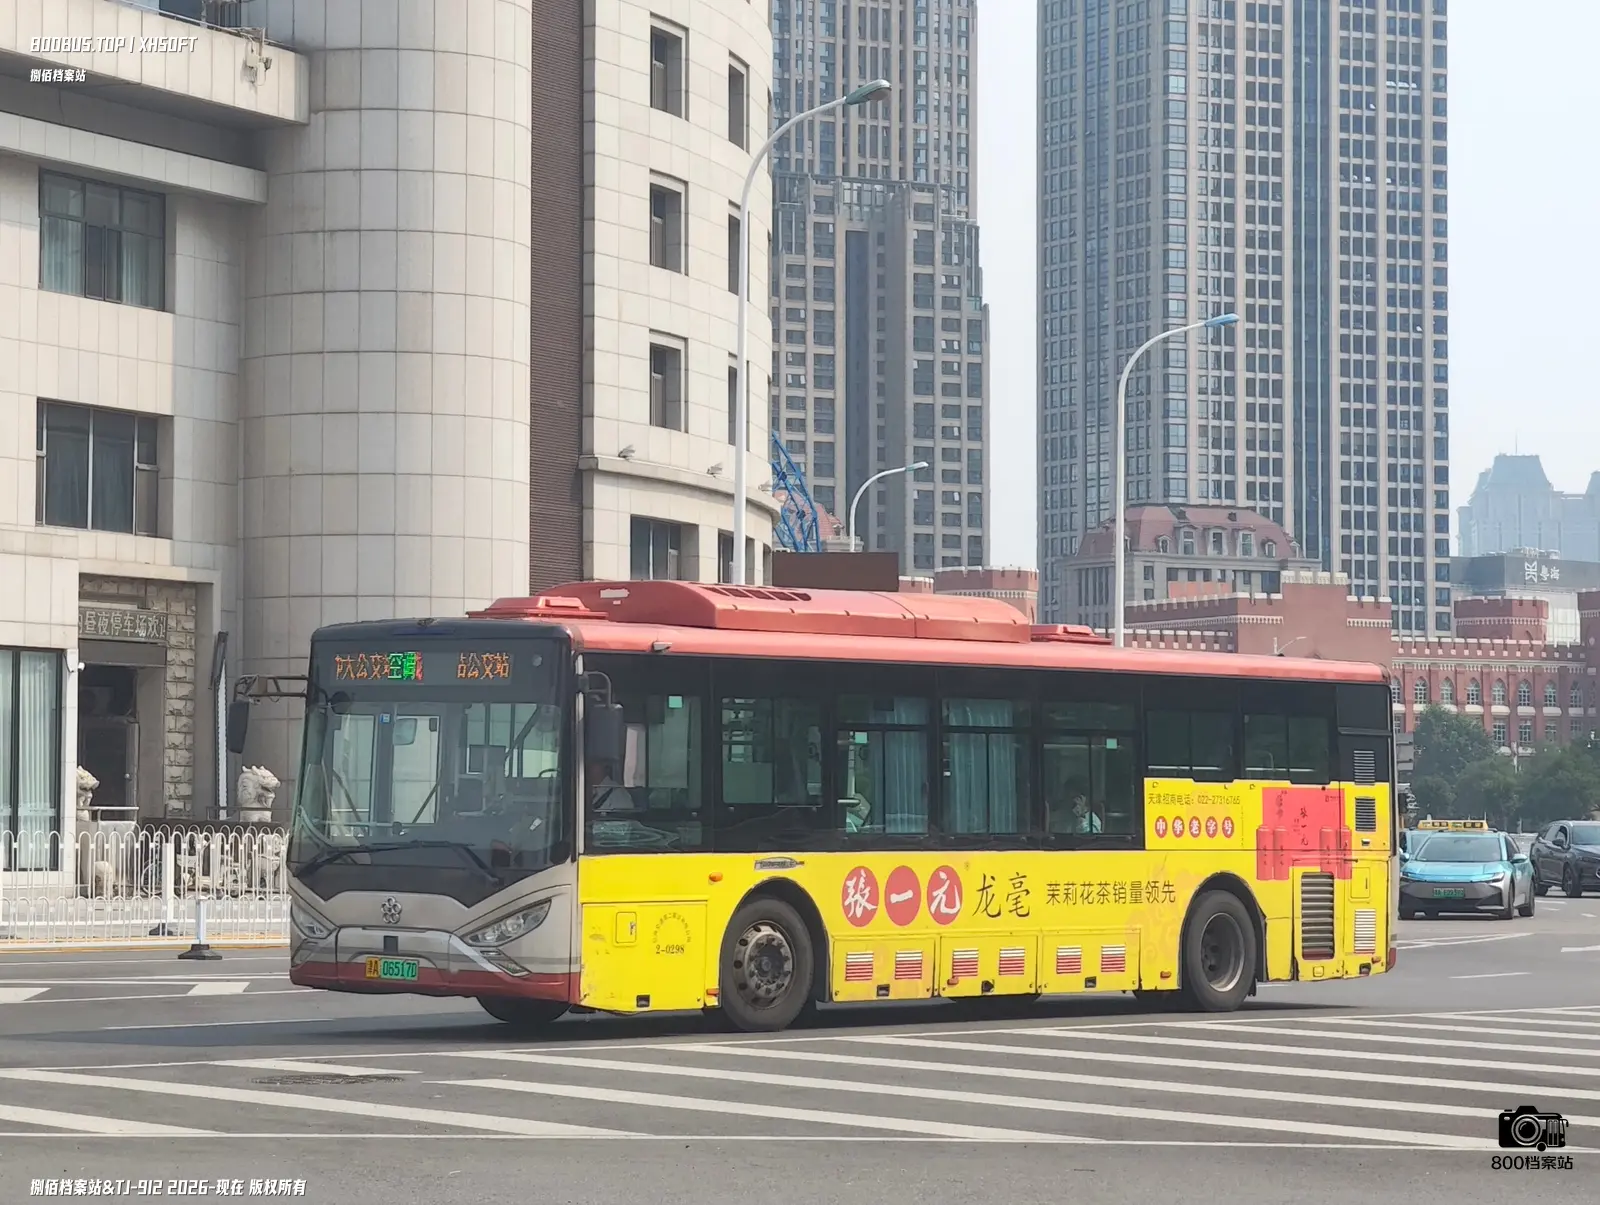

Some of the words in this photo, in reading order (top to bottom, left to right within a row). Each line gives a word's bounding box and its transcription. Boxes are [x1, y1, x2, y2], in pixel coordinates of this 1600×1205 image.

[972, 871, 1031, 919] 龙毫
[1046, 880, 1176, 905] 茉莉花茶销量领先
[655, 944, 685, 955] 2-0298
